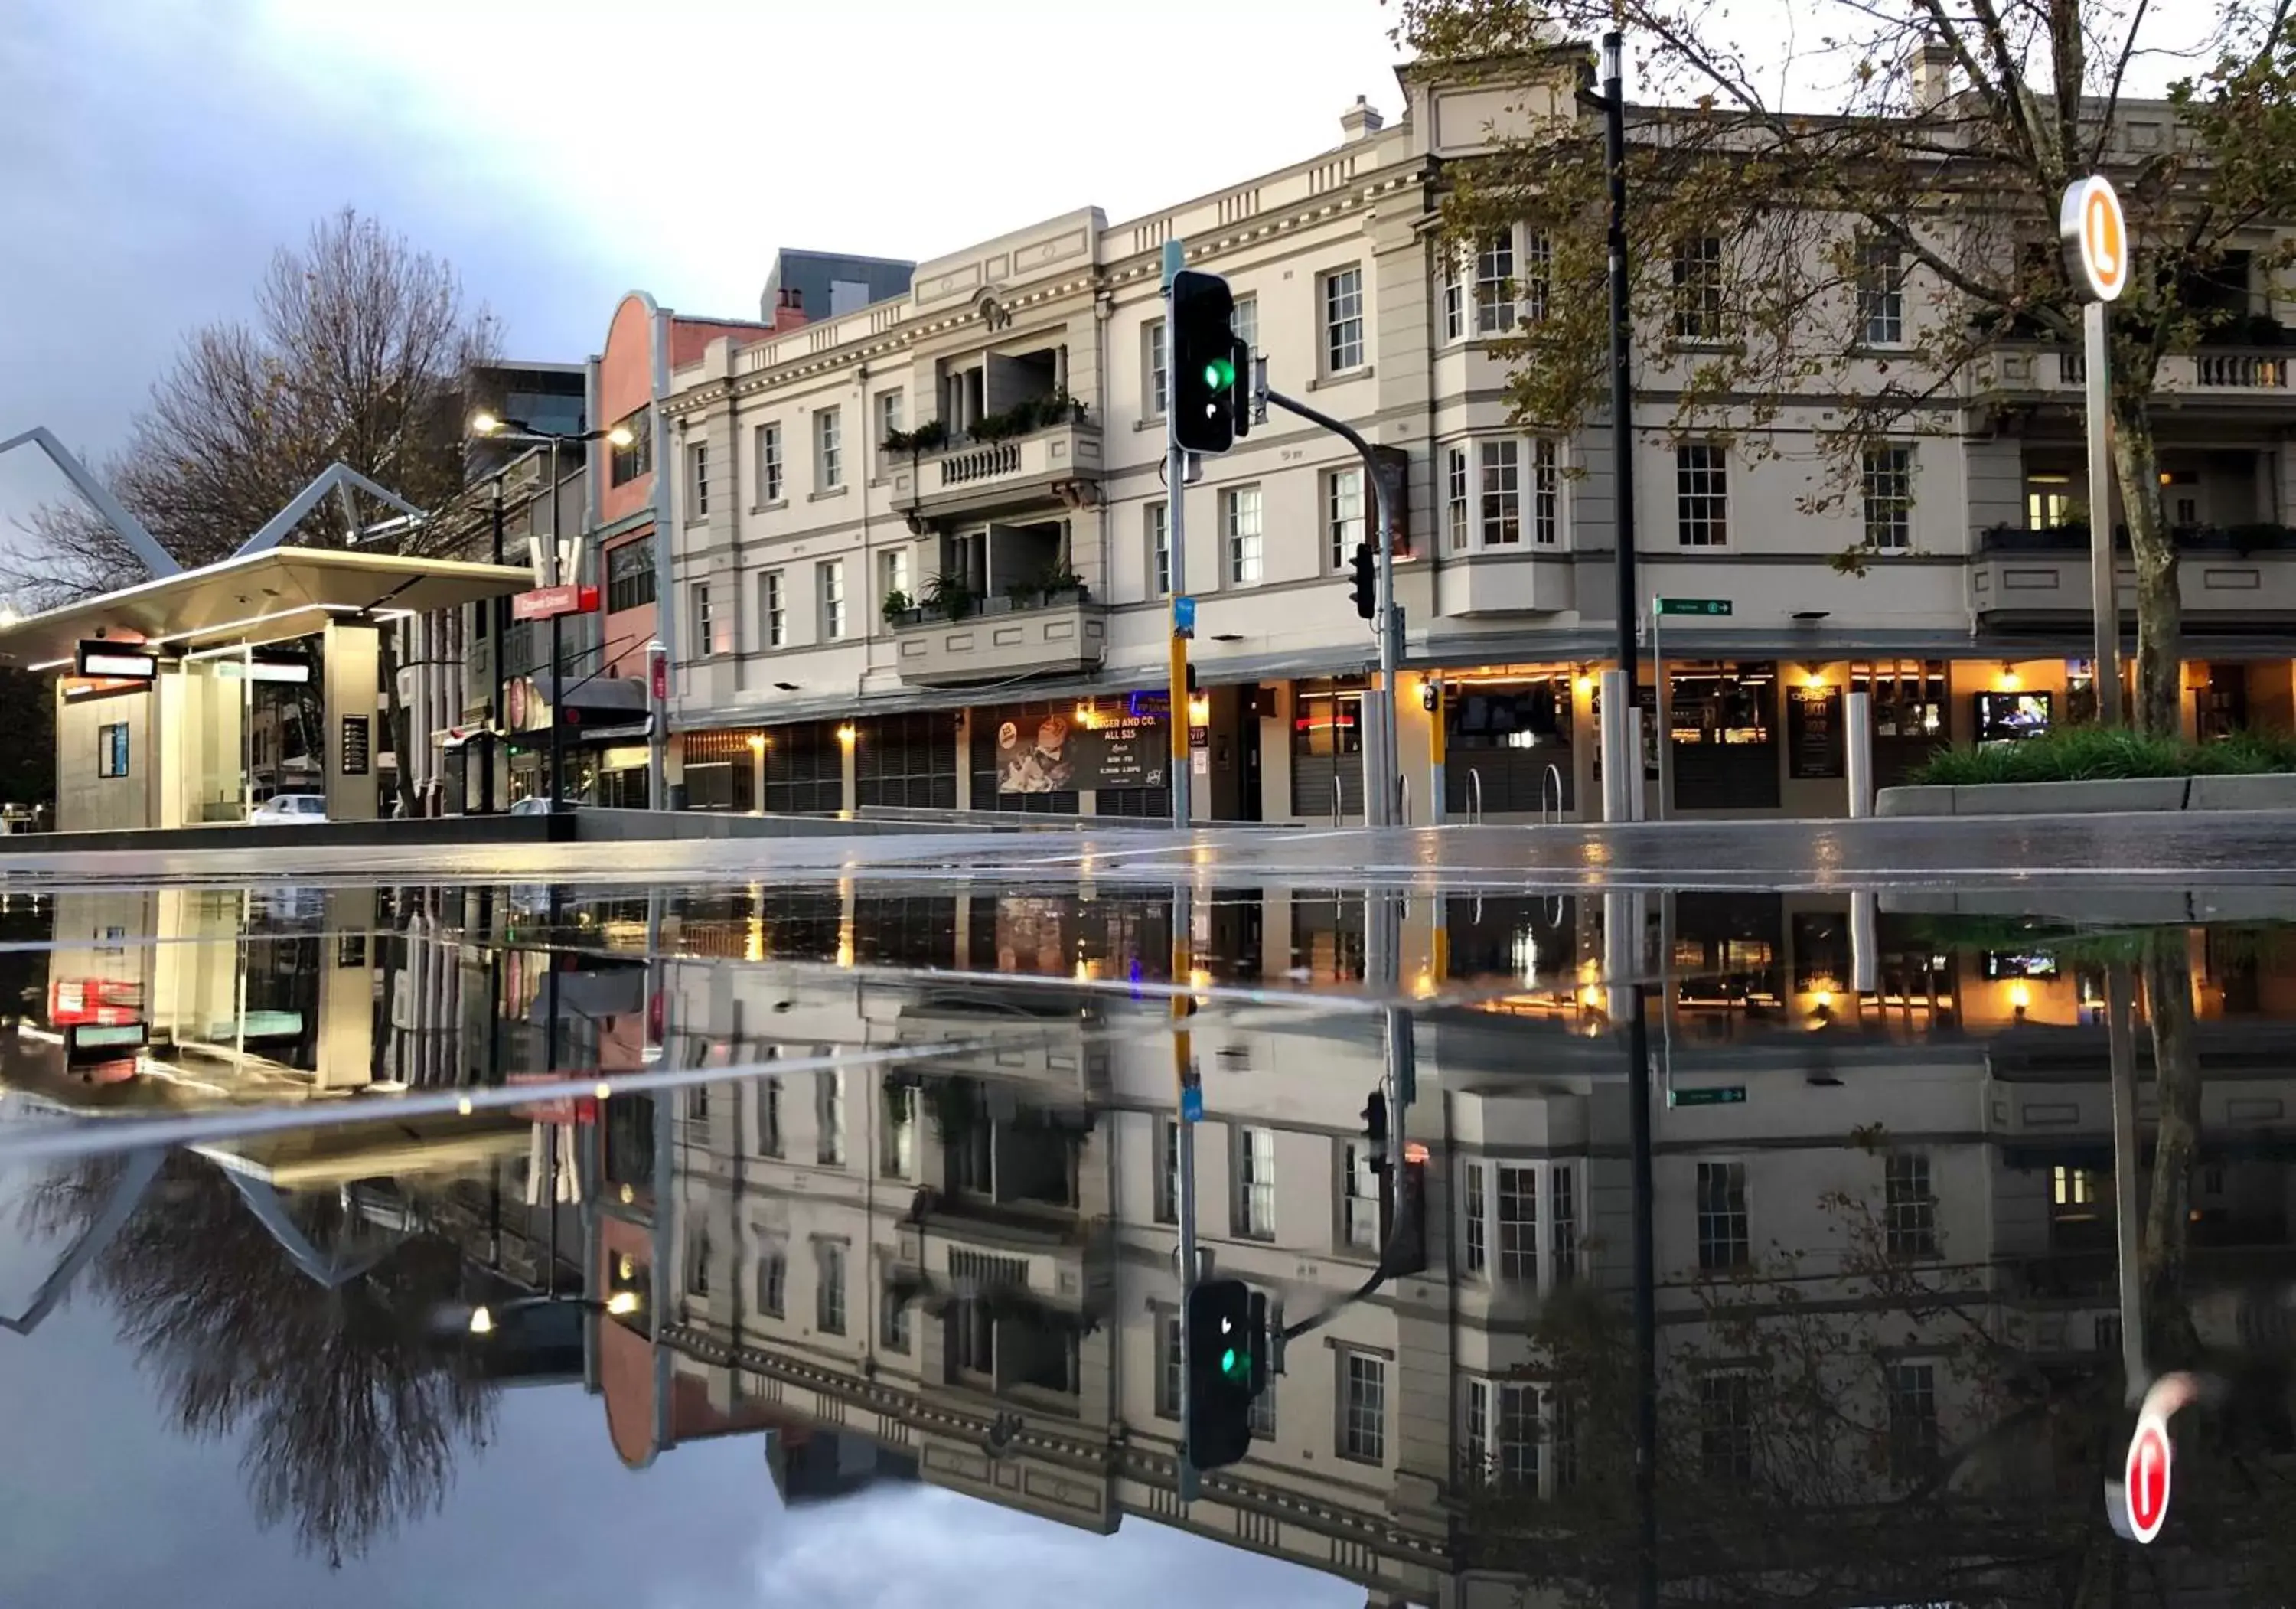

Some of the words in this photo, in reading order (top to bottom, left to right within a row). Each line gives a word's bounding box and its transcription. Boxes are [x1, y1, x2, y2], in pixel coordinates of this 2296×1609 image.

[2093, 200, 2115, 273] L
[1121, 716, 1140, 727] AND
[1141, 715, 1156, 726] CO.
[1104, 729, 1120, 741] ALL
[1190, 732, 1205, 740] VIP
